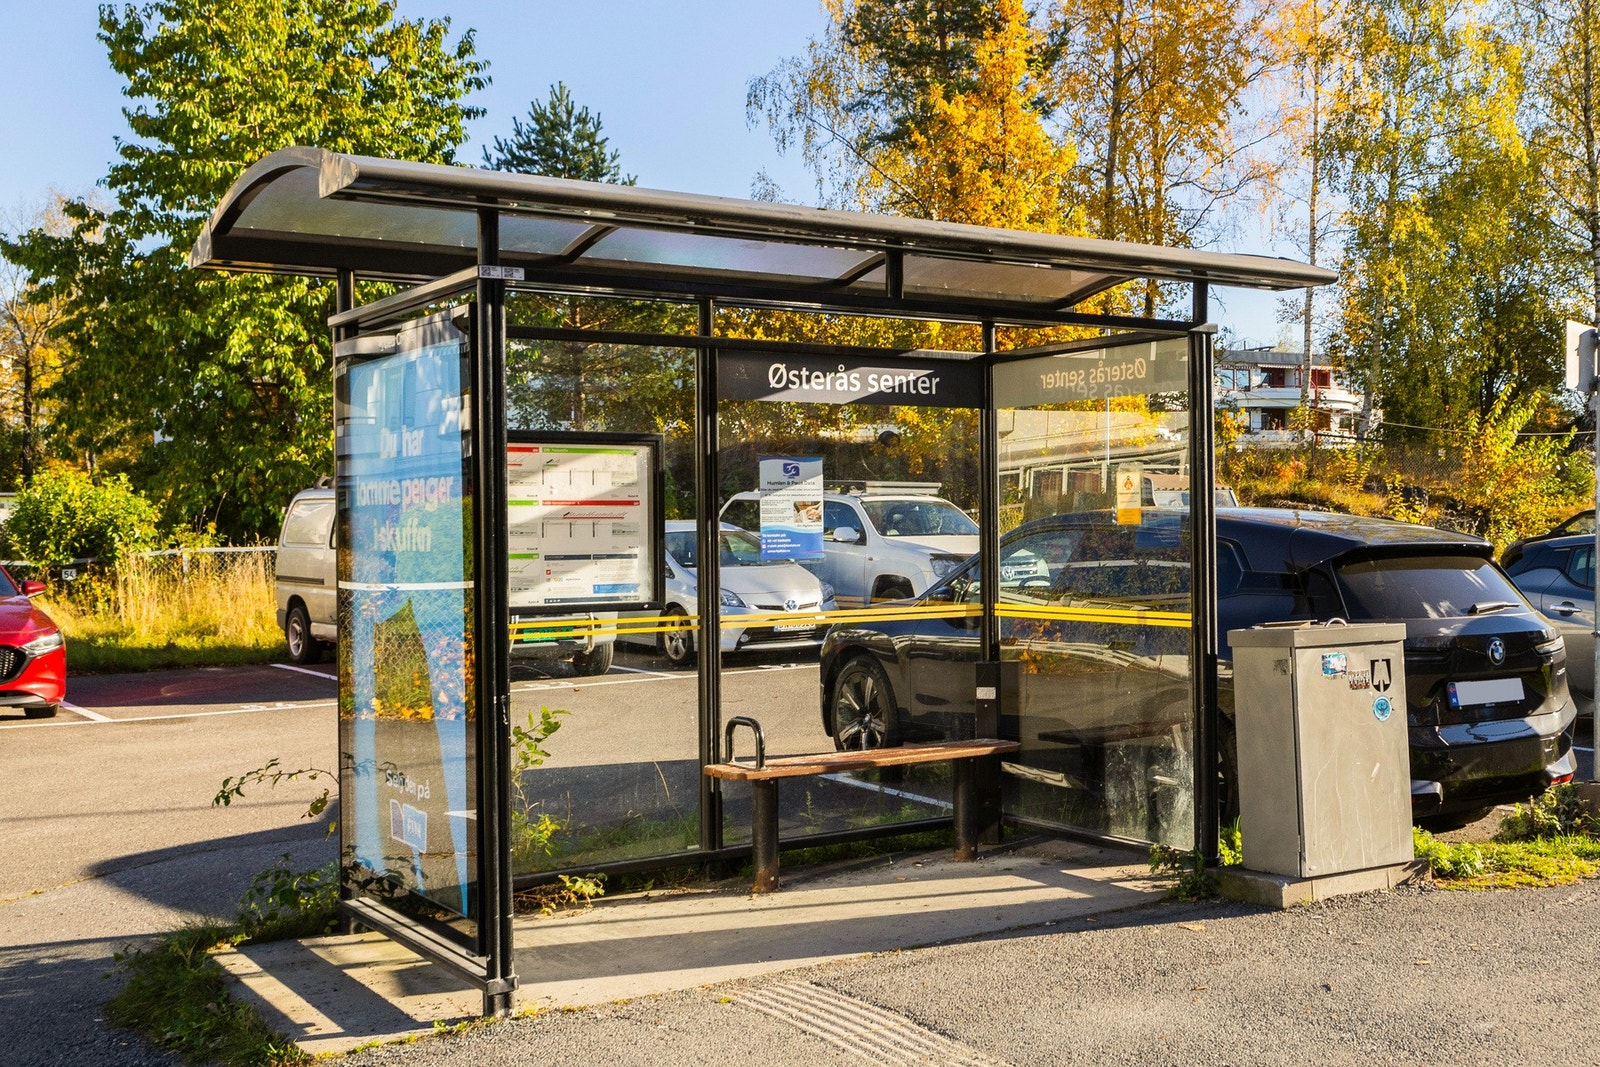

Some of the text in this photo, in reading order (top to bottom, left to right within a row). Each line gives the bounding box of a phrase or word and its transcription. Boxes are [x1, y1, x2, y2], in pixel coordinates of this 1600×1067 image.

[768, 363, 940, 395] Østerås senter
[381, 424, 424, 459] Du har
[417, 779, 430, 801] på
